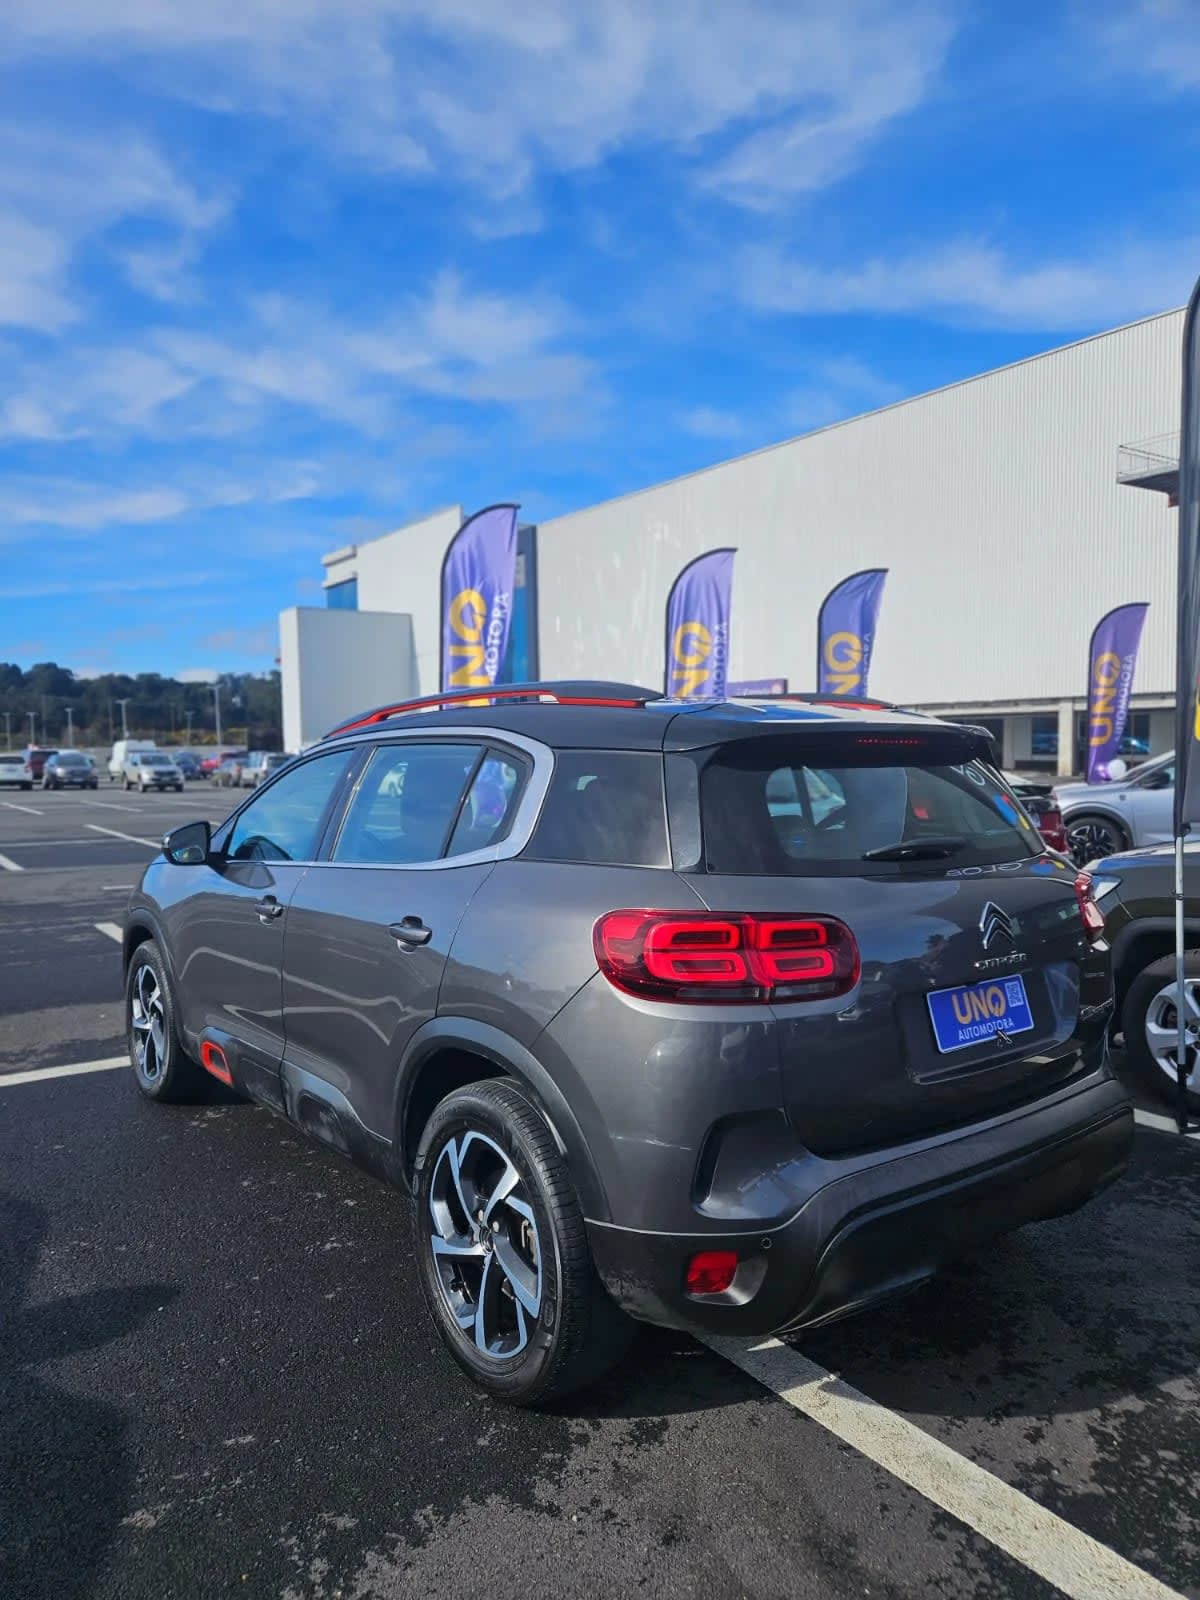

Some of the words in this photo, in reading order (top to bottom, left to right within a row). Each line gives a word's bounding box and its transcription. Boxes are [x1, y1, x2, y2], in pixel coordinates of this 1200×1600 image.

[1089, 652, 1121, 747] UNO
[951, 986, 1007, 1025] UNO
[958, 1017, 1015, 1041] AUTOMOTORA
